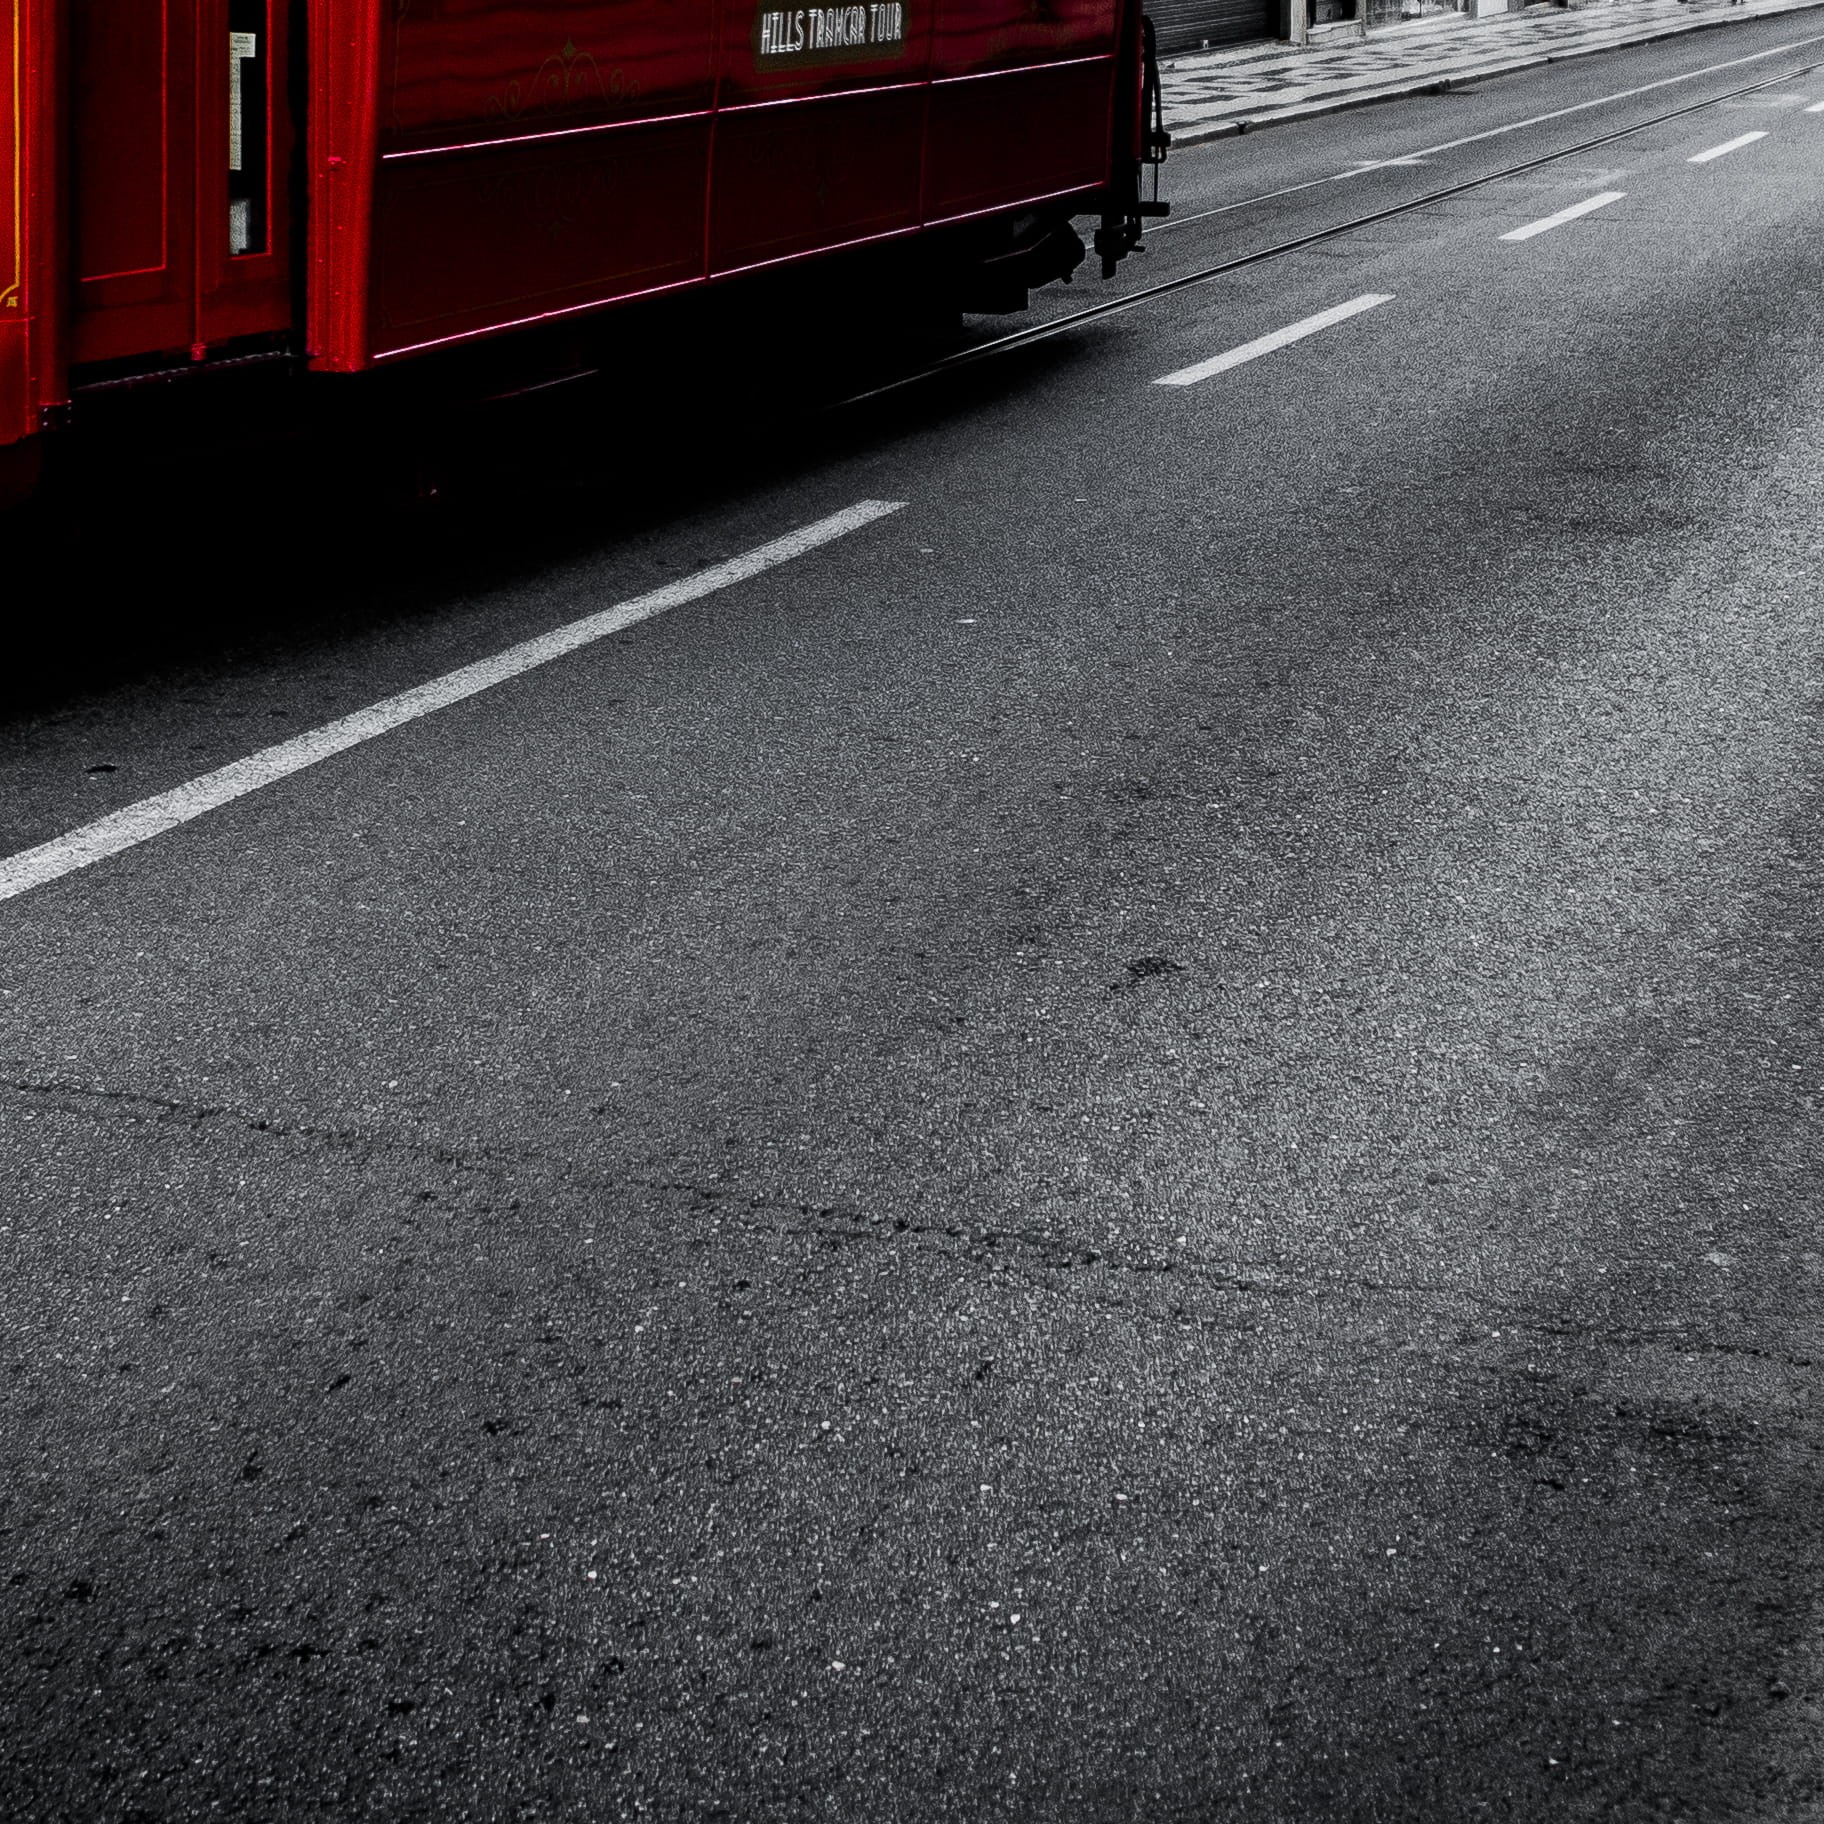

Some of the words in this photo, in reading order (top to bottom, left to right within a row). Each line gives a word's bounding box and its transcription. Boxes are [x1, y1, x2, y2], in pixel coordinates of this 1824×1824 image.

[761, 10, 805, 54] HILLS
[808, 6, 866, 50] TRAMCAR
[870, 2, 901, 43] TOUR
